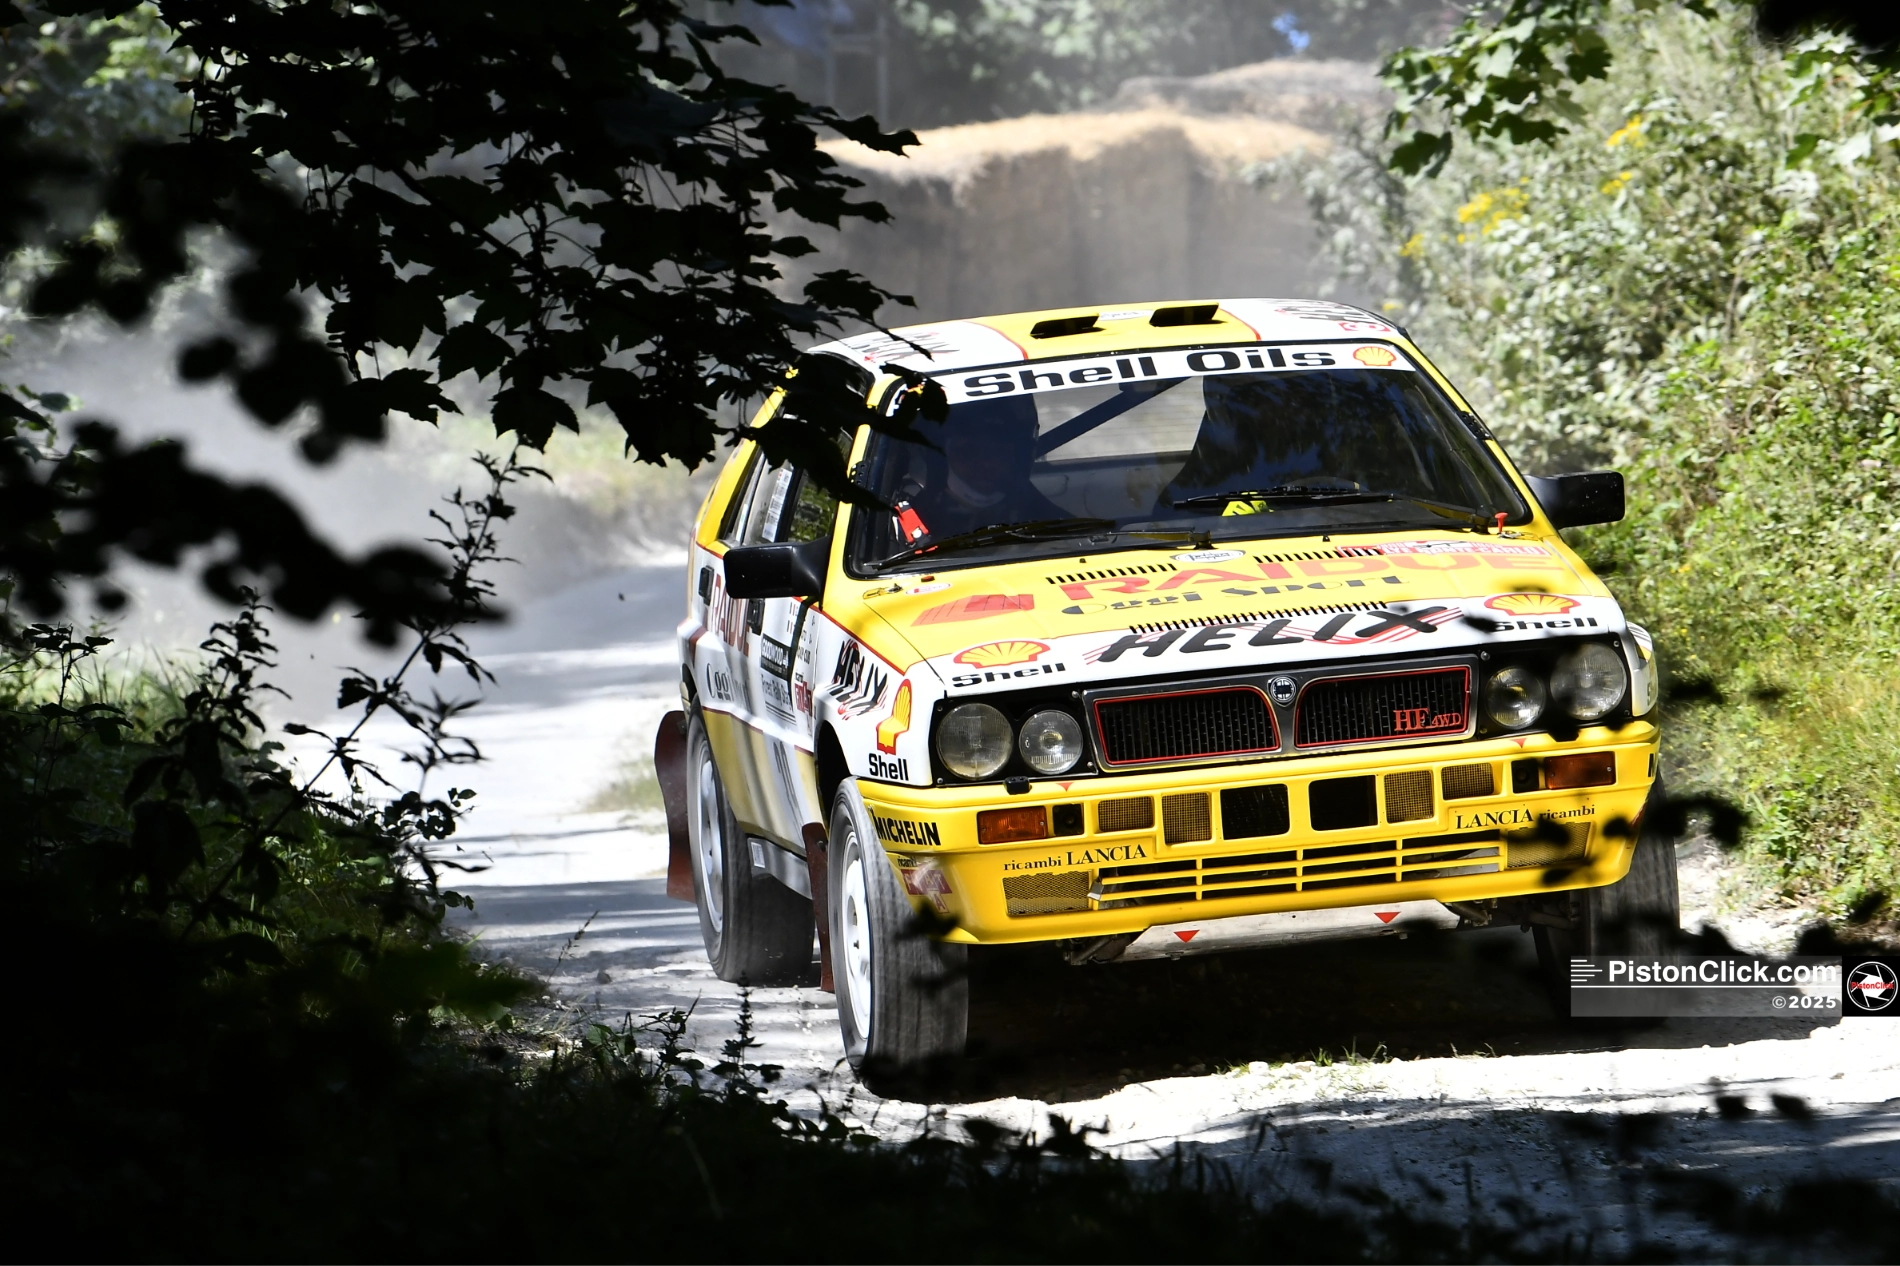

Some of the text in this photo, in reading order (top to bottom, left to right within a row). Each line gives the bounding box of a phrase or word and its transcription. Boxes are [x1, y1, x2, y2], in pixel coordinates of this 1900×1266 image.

[964, 349, 1336, 397] Shell Oils
[1058, 552, 1566, 600] RAIDUE
[1061, 575, 1408, 615] Oggi Sport
[1096, 605, 1448, 663] HELIX
[1492, 617, 1599, 632] Shell
[951, 662, 1066, 687] Shell
[1393, 707, 1462, 731] HF 4WD
[868, 753, 909, 781] Shell
[874, 815, 941, 846] MICHELIN
[1456, 804, 1595, 830] LANCIA ricambi
[1004, 843, 1147, 871] ricambi LANCIA
